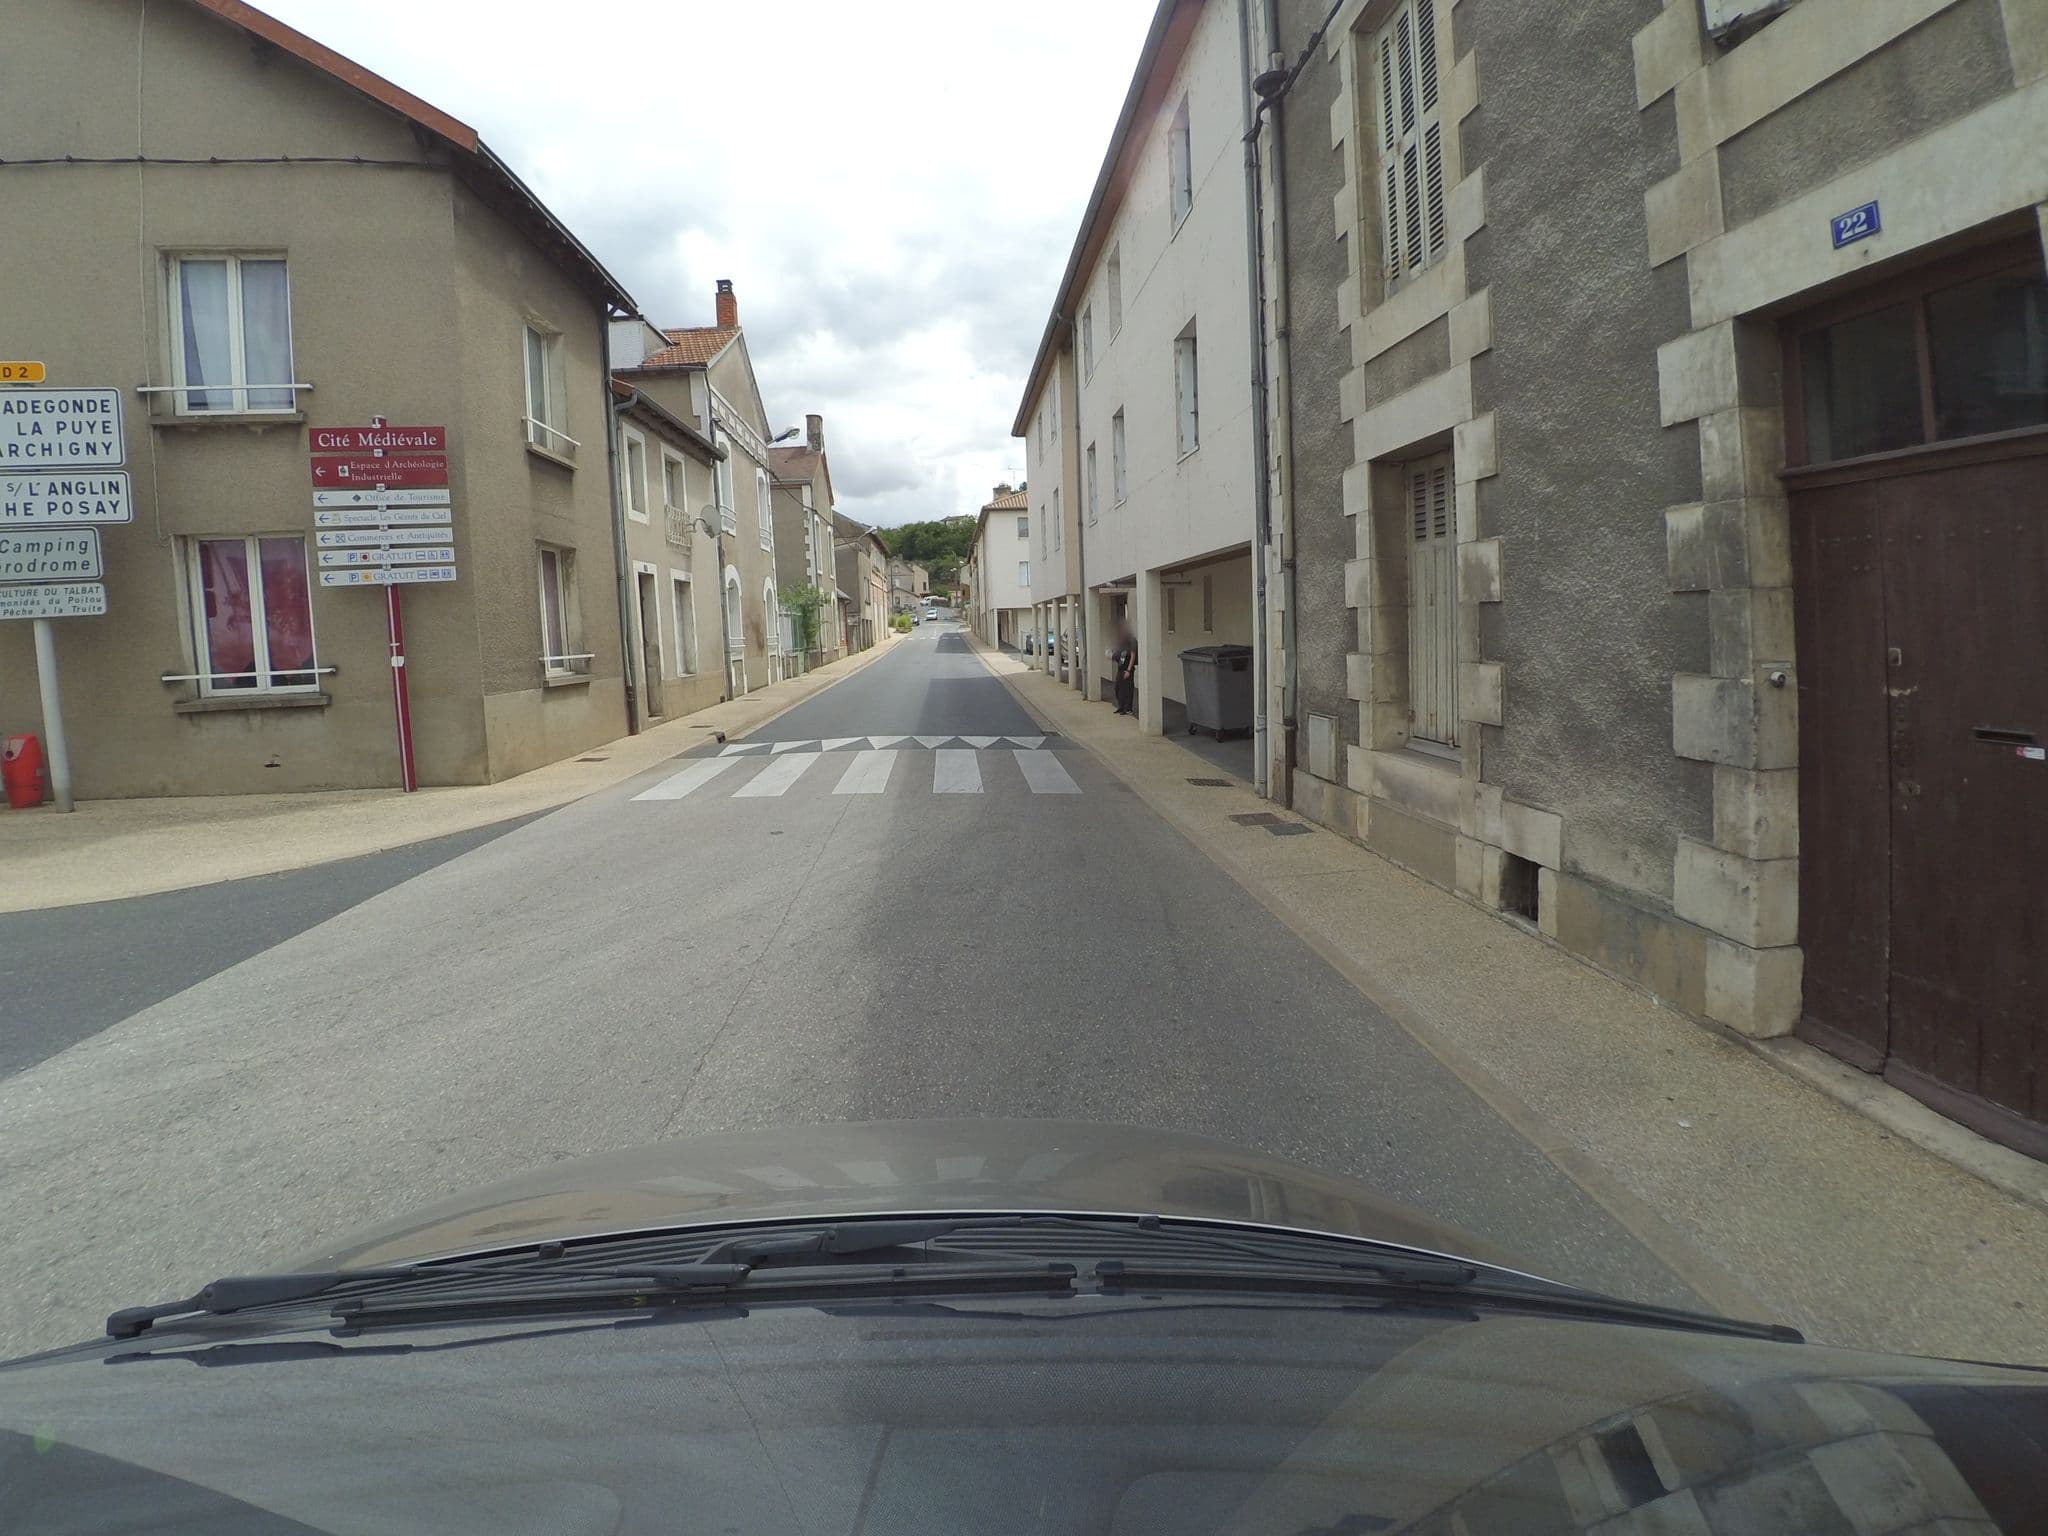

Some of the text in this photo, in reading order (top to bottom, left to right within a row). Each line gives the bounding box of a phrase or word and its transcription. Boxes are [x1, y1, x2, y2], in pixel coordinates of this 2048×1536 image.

[1840, 211, 1868, 240] 22
[3, 367, 28, 378] D 2
[0, 399, 111, 414] ADEGONDE
[17, 420, 113, 435] LA PUYE
[318, 431, 437, 447] Cité Médiévale
[350, 461, 380, 470] Espace
[351, 472, 402, 481] Industrielle
[364, 493, 388, 501] Office
[408, 492, 445, 501] Tourisme
[0, 500, 120, 516] HE POSAY
[0, 537, 88, 555] Camping
[371, 552, 413, 561] GRATUIT
[0, 558, 90, 573] rodrome
[373, 571, 414, 580] GRATUIT
[0, 586, 100, 598] ULTURE DU TALBAT
[48, 598, 60, 606] du
